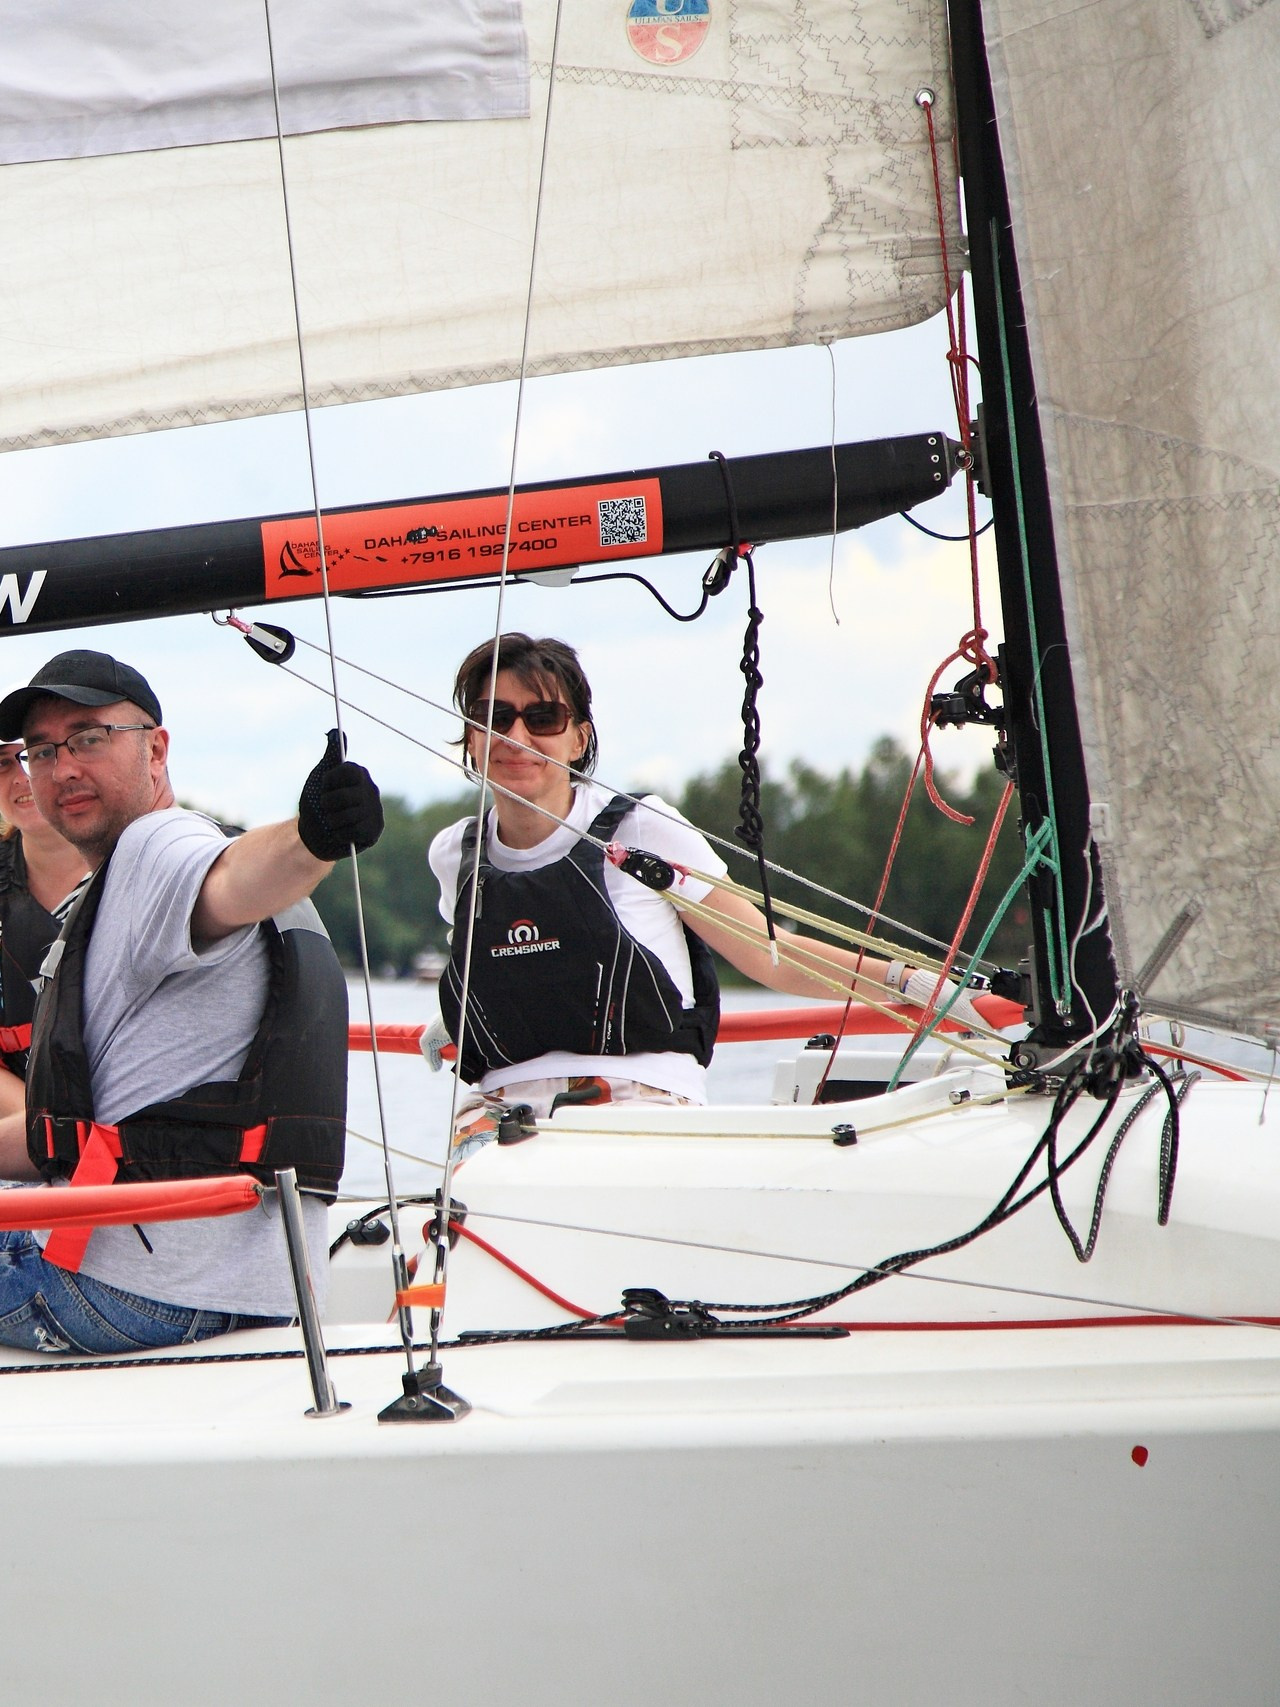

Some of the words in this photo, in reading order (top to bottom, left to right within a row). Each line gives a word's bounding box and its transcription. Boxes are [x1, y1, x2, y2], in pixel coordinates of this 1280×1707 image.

[635, 15, 672, 24] ULLMAN
[436, 524, 507, 542] SAILING
[518, 514, 592, 533] CENTER
[401, 548, 461, 565] +7916
[467, 537, 558, 558] 1927400
[491, 940, 560, 957] CREWSAVER
